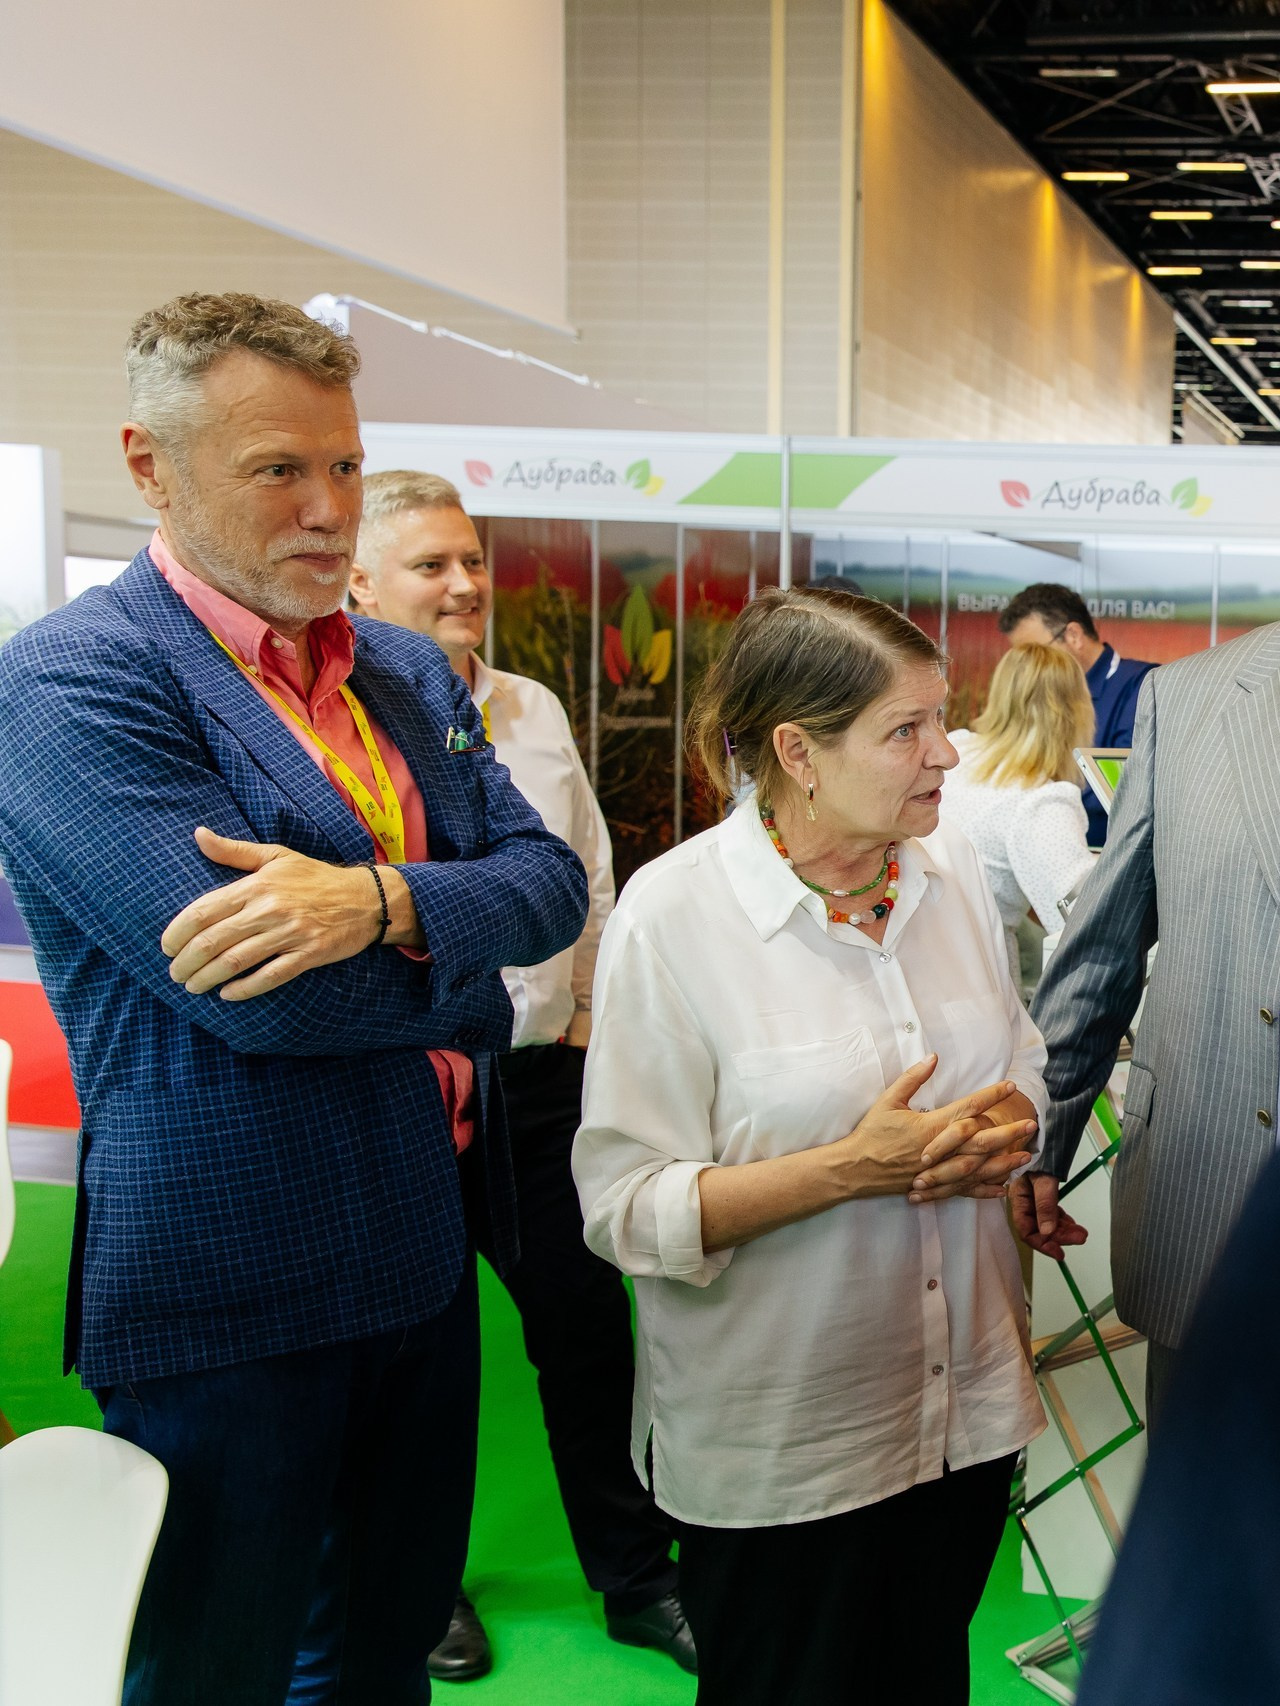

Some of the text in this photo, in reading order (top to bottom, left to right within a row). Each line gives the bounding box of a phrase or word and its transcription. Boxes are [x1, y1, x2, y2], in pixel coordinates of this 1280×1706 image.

[502, 457, 617, 491] Дубрава
[1041, 477, 1161, 513] Дубрава
[1087, 598, 1127, 617] ДЛЯ
[1131, 600, 1176, 619] ВАС!
